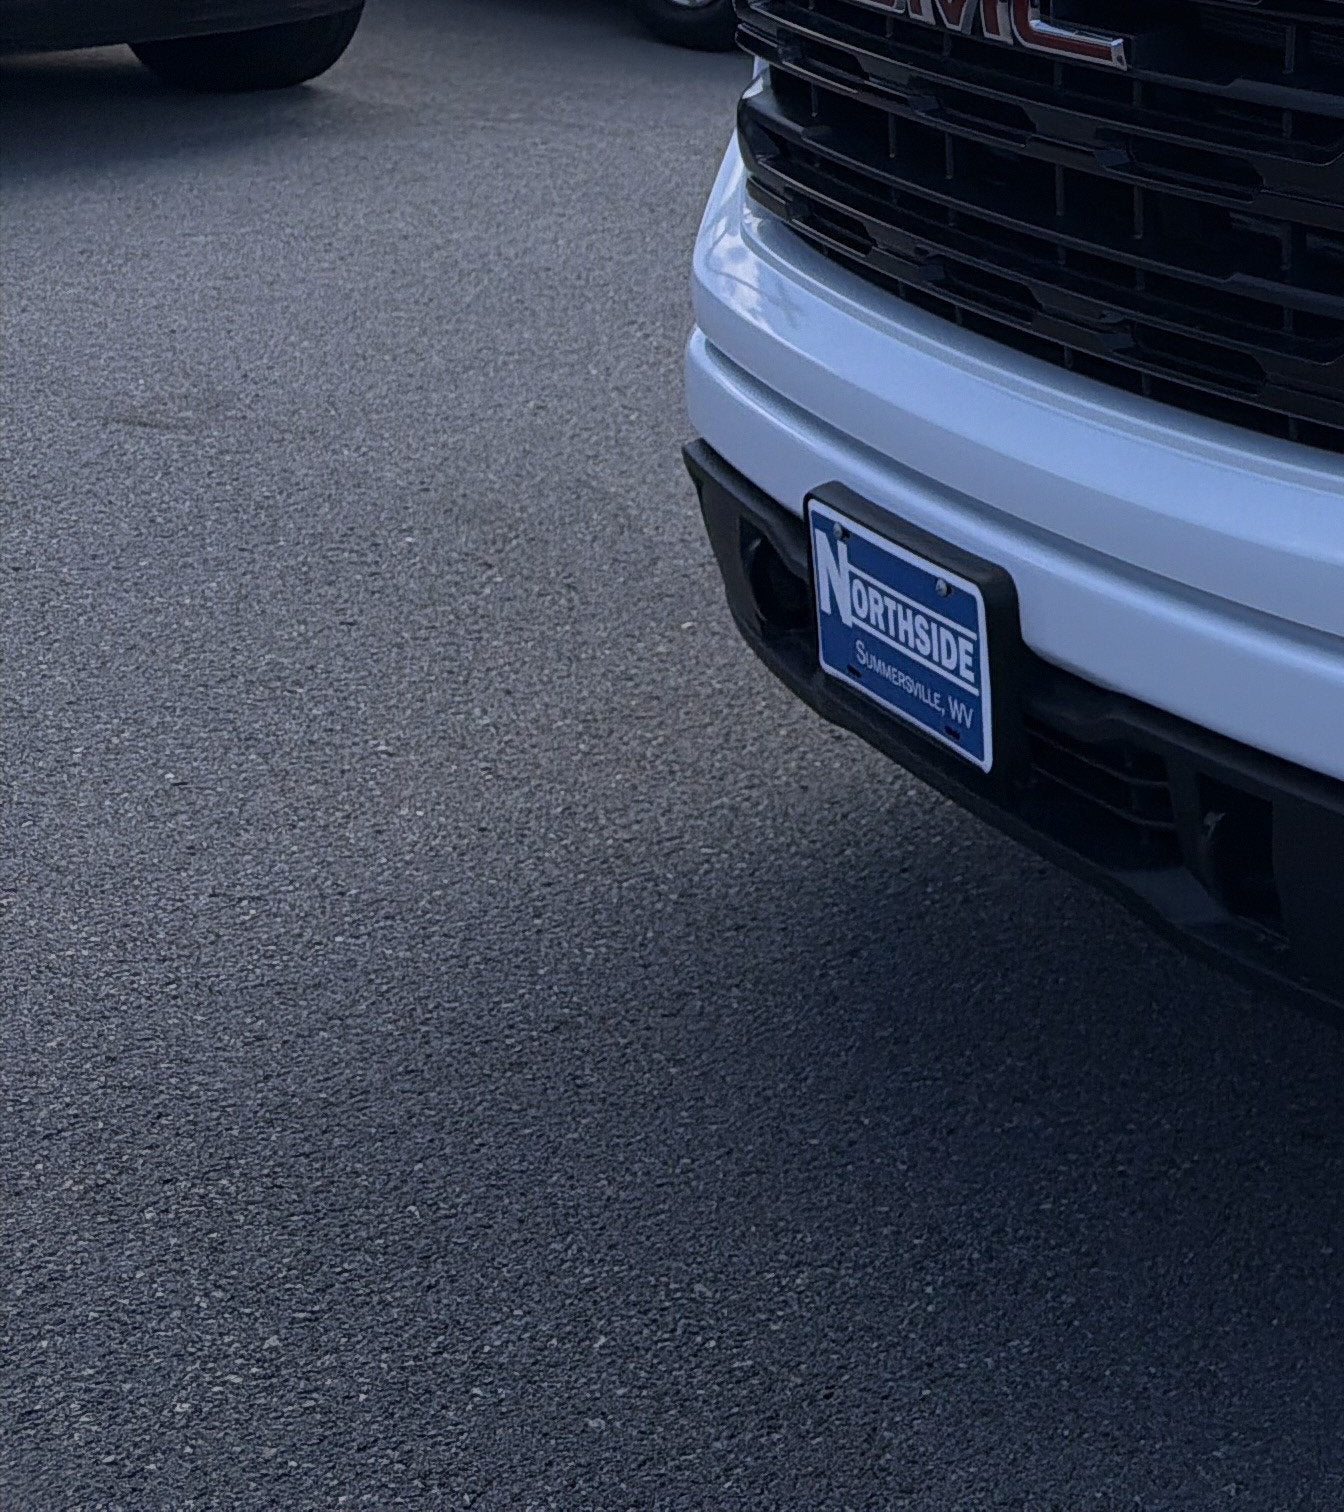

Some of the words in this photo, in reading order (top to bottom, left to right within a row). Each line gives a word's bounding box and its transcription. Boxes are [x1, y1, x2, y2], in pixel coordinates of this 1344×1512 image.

[814, 528, 976, 684] NORTHSIDE
[855, 639, 946, 716] SUMMERSVILLE,
[947, 694, 974, 729] WV
